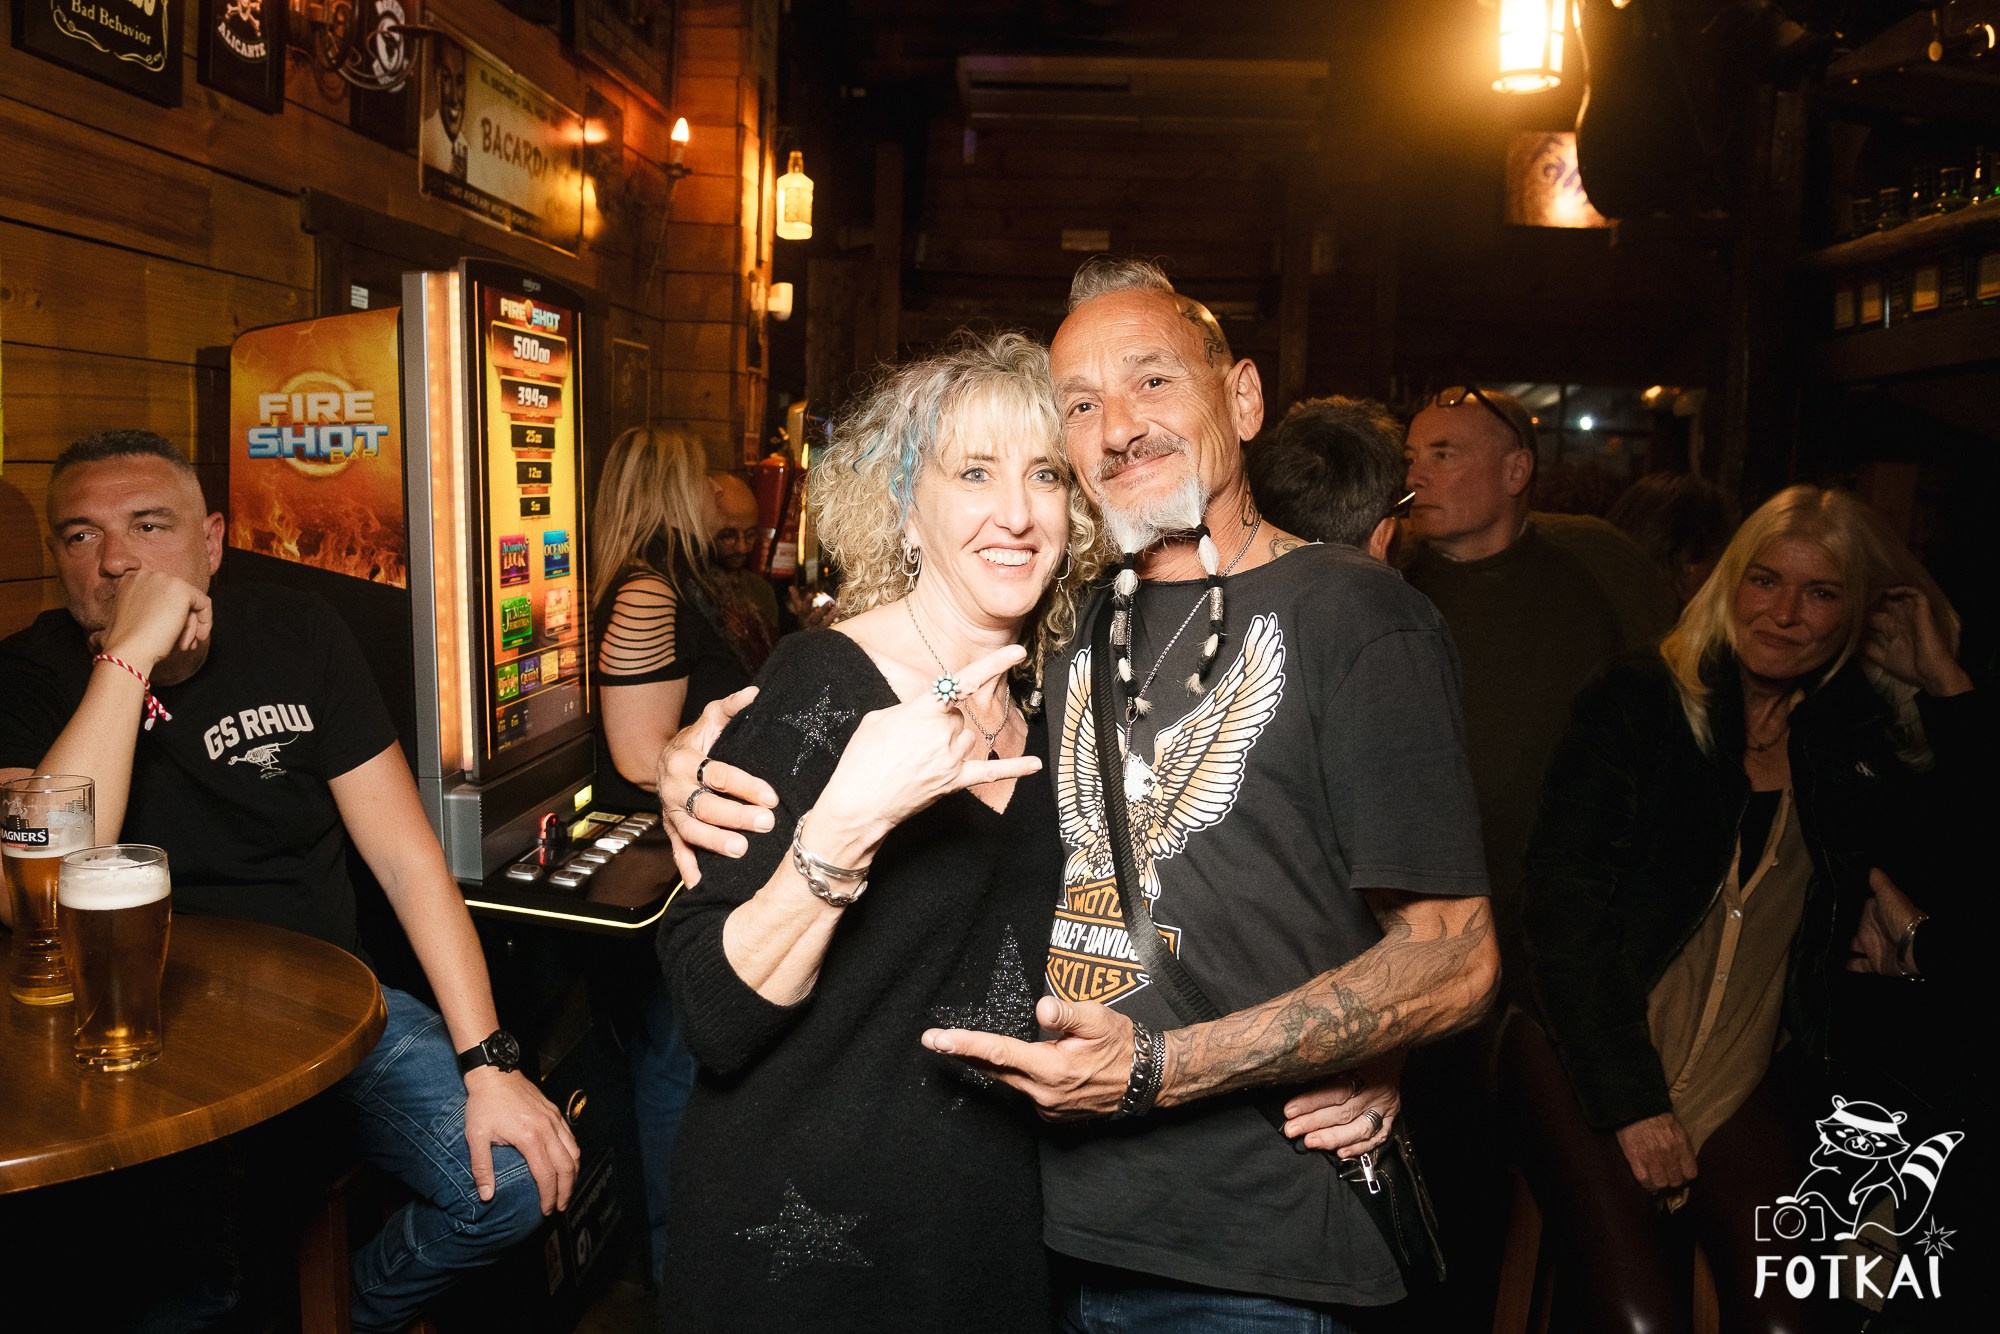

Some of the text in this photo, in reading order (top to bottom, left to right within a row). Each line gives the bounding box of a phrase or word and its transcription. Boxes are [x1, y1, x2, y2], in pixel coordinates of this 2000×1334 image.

[71, 0, 95, 20] Bad
[100, 7, 152, 45] Behavior
[217, 21, 266, 58] ALICANTE
[500, 297, 560, 329] FIRE SHOT
[258, 391, 375, 426] FIRE
[248, 424, 389, 459] SHOT
[330, 449, 378, 463] BAR
[203, 703, 315, 760] GS RAW
[1073, 885, 1123, 918] MOTO
[1053, 957, 1122, 1001] CYCLES
